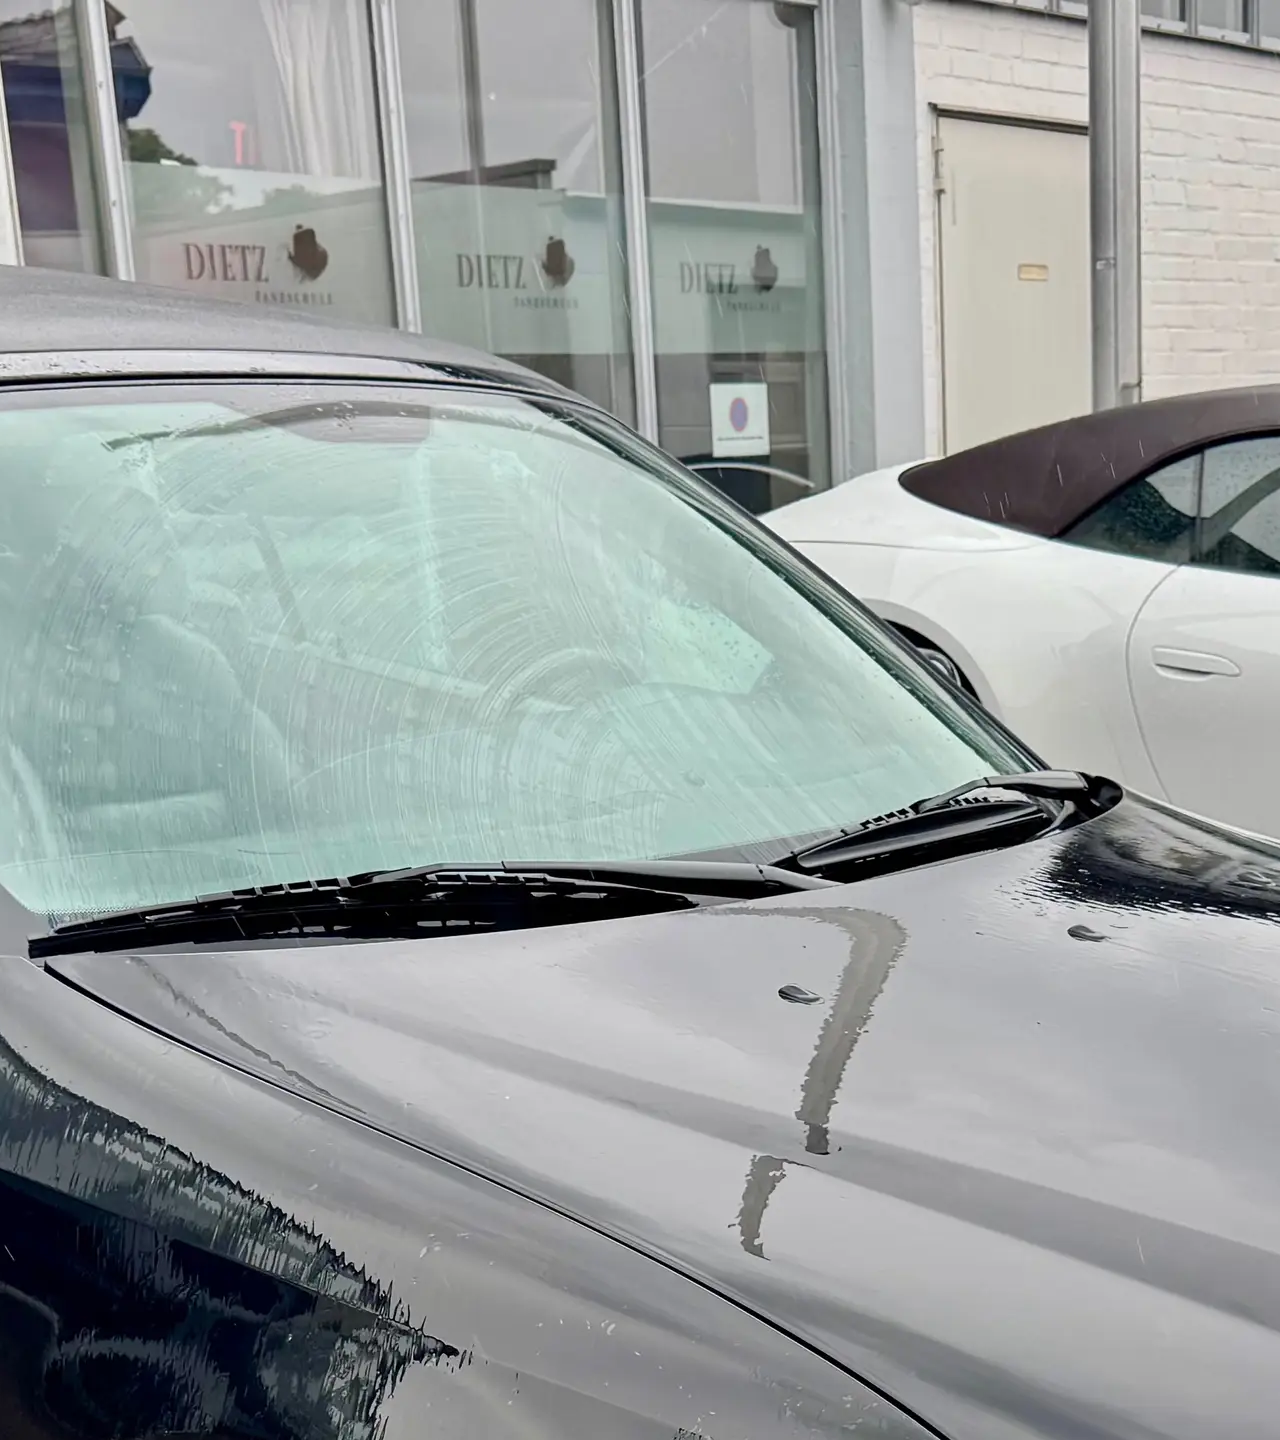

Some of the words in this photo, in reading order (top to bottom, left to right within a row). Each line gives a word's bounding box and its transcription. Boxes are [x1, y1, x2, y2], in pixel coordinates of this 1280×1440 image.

[182, 242, 269, 283] DIETZ
[455, 253, 527, 289] DIETZ
[679, 262, 739, 294] DIETZ
